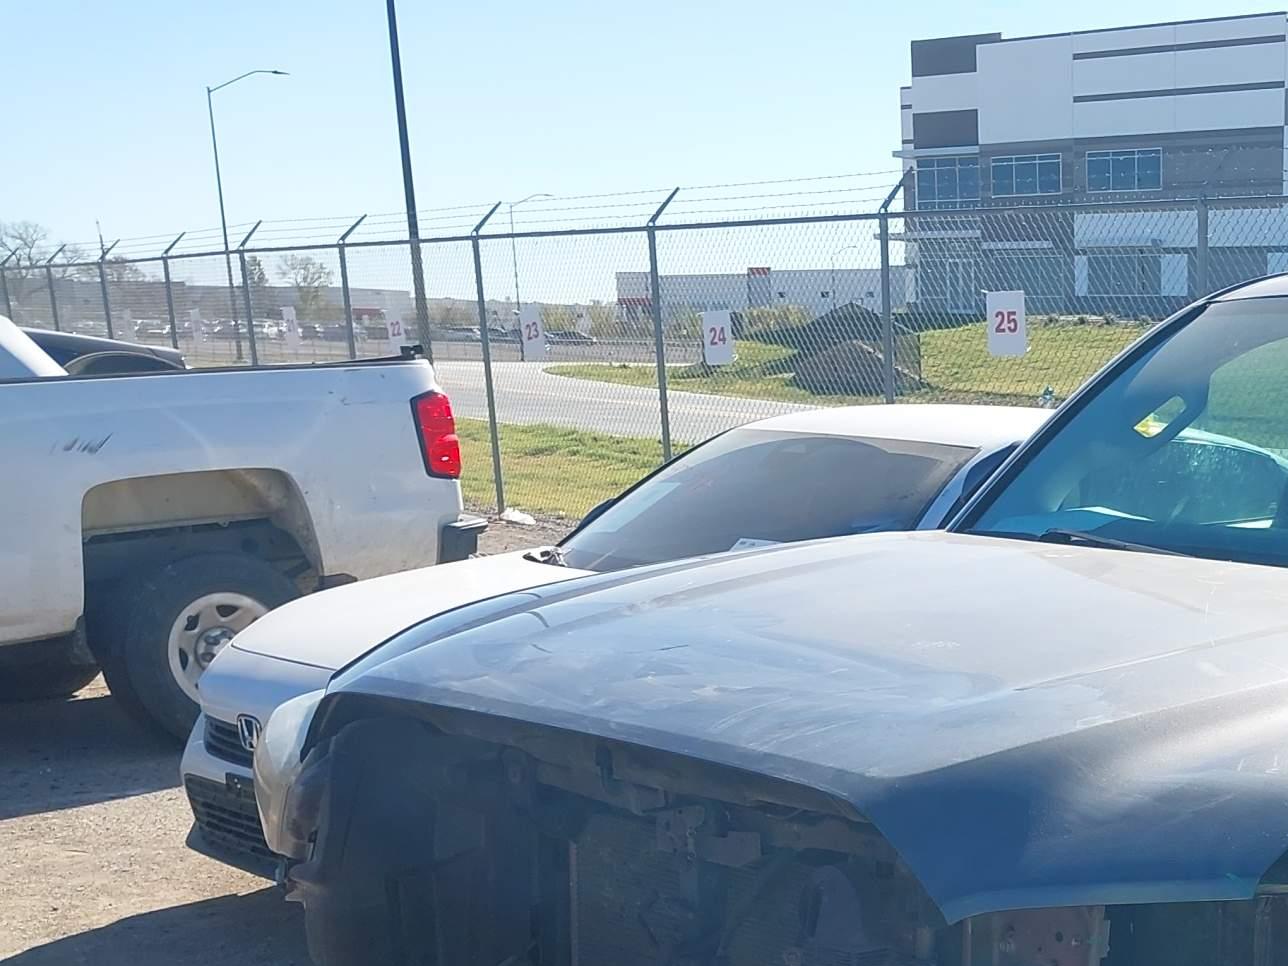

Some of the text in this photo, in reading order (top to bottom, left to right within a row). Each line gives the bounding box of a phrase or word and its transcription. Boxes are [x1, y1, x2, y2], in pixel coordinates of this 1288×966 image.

[390, 321, 401, 336] 22
[525, 322, 540, 340] 23
[995, 310, 1018, 333] 25
[709, 326, 727, 346] 24
